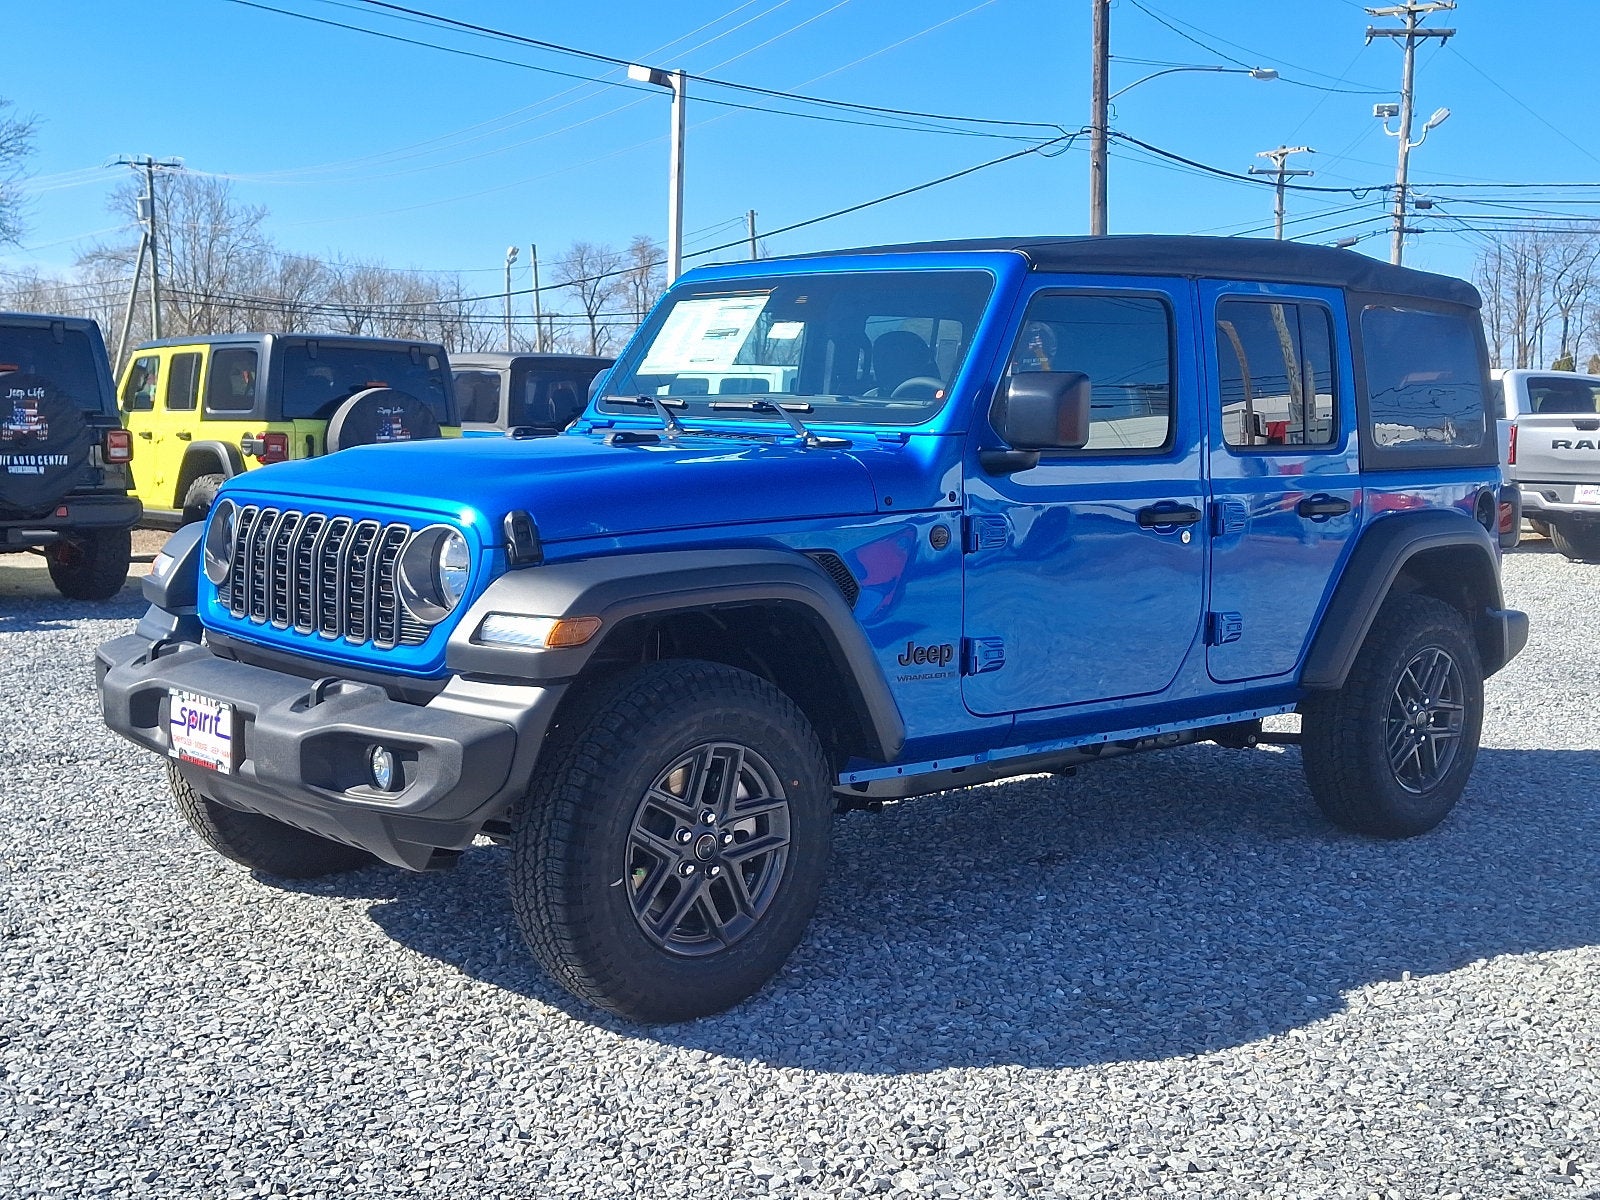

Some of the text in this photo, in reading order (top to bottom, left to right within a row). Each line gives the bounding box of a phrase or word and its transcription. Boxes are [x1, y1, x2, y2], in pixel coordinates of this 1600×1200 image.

[5, 387, 45, 399] Jeep Life
[1552, 440, 1600, 449] RA
[13, 455, 36, 465] AUTO
[37, 454, 68, 465] CENTER
[897, 641, 954, 667] Jeep
[896, 672, 946, 682] WRANGLER
